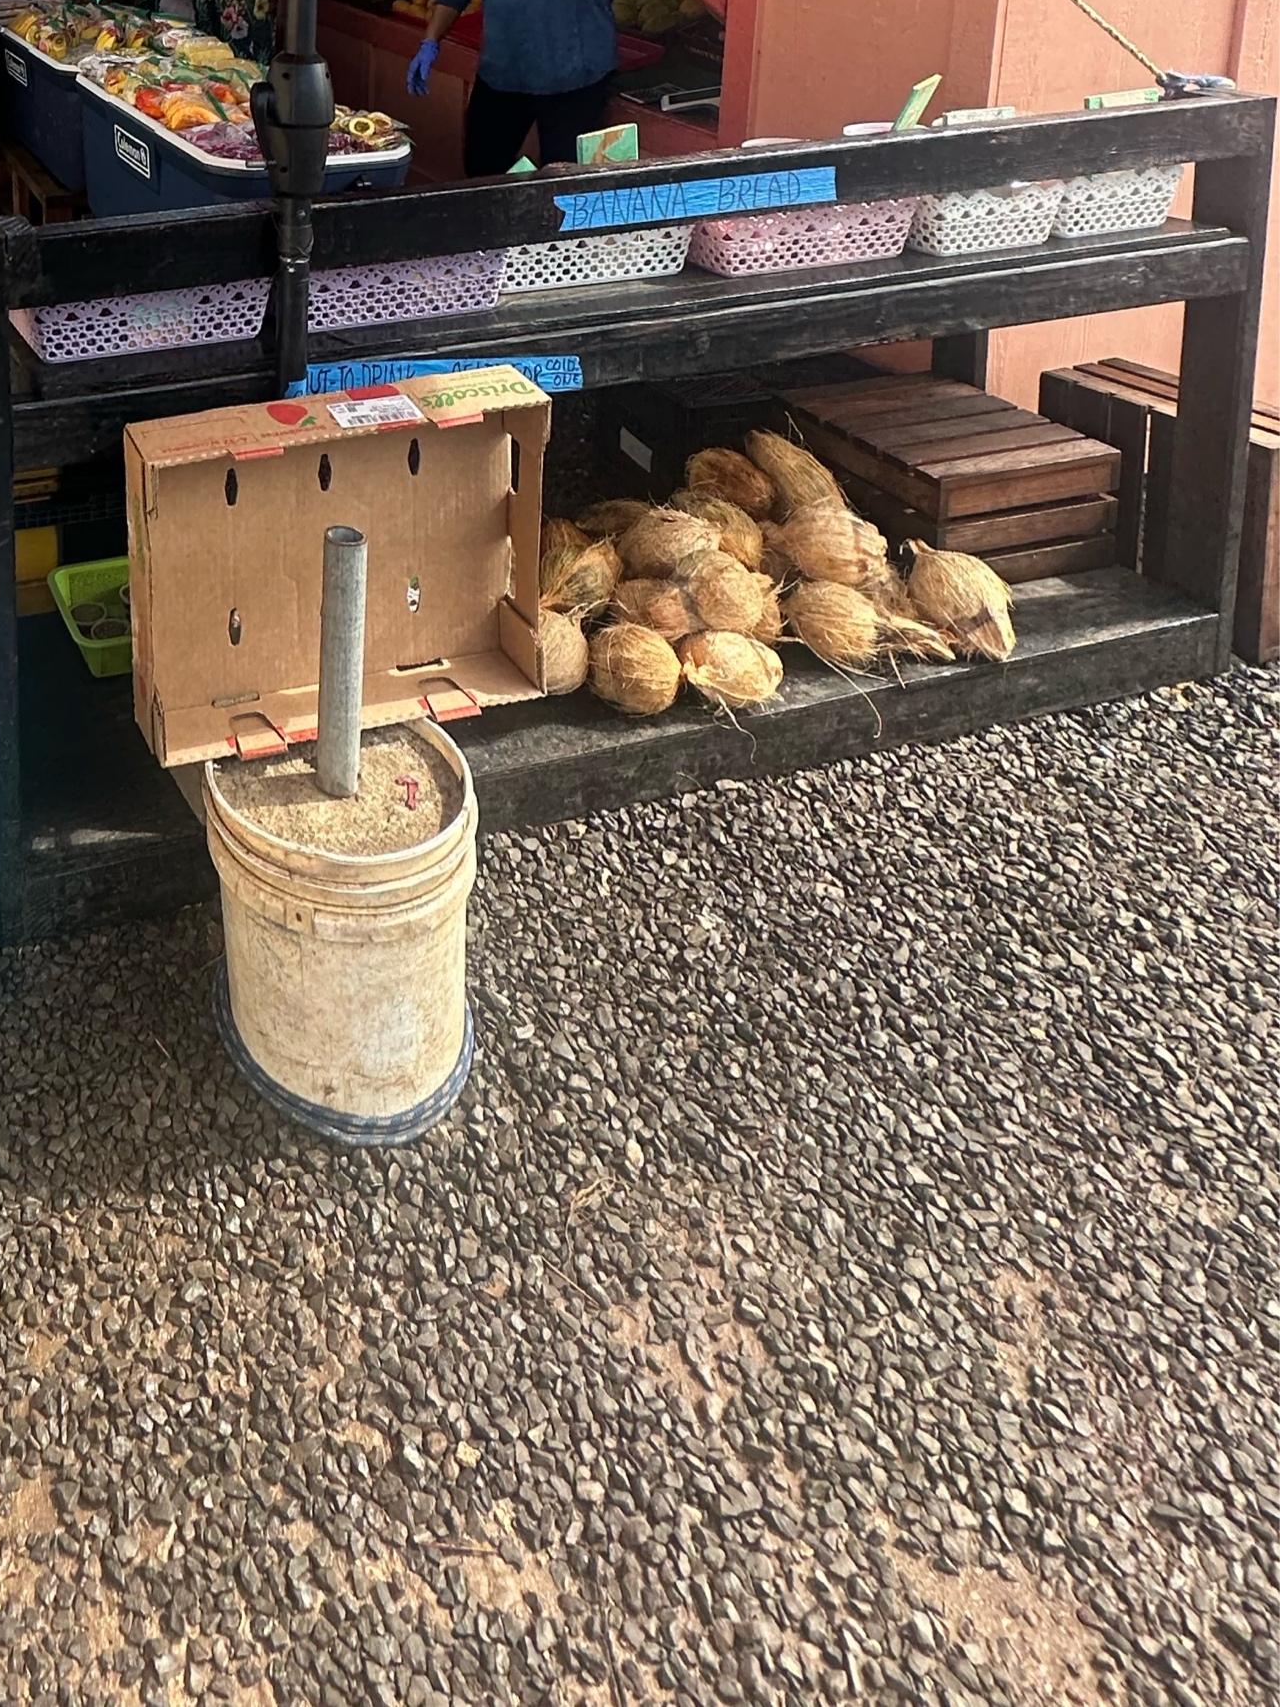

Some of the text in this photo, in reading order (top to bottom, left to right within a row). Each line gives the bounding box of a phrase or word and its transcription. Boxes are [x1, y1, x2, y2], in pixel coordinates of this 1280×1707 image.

[572, 171, 802, 229] BANANA BREAD
[553, 373, 580, 387] ONE
[421, 381, 535, 409] Driscoll's
